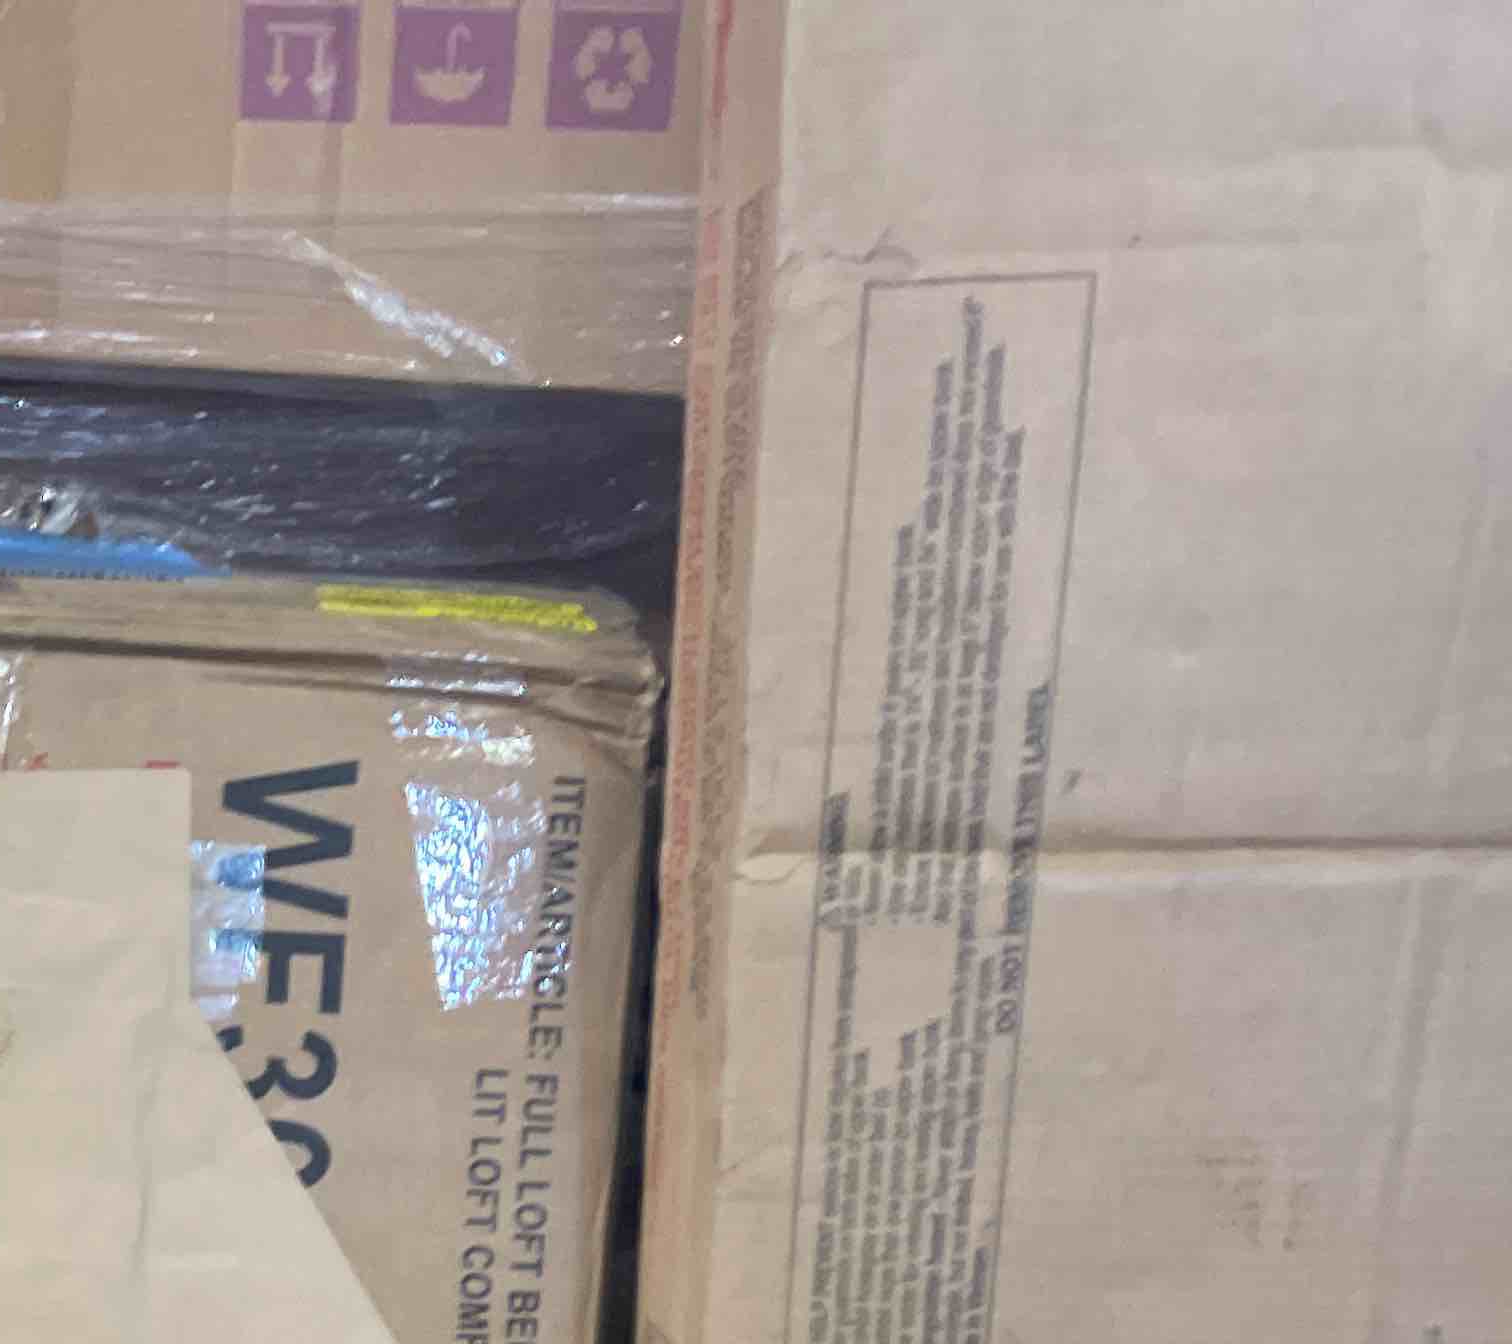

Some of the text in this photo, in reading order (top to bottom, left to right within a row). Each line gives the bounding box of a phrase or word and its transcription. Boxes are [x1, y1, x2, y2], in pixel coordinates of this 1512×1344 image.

[473, 1068, 509, 1123] LIT
[519, 1073, 559, 1168] FULL
[463, 1137, 502, 1232] LOFT
[510, 1181, 550, 1278] LOFT
